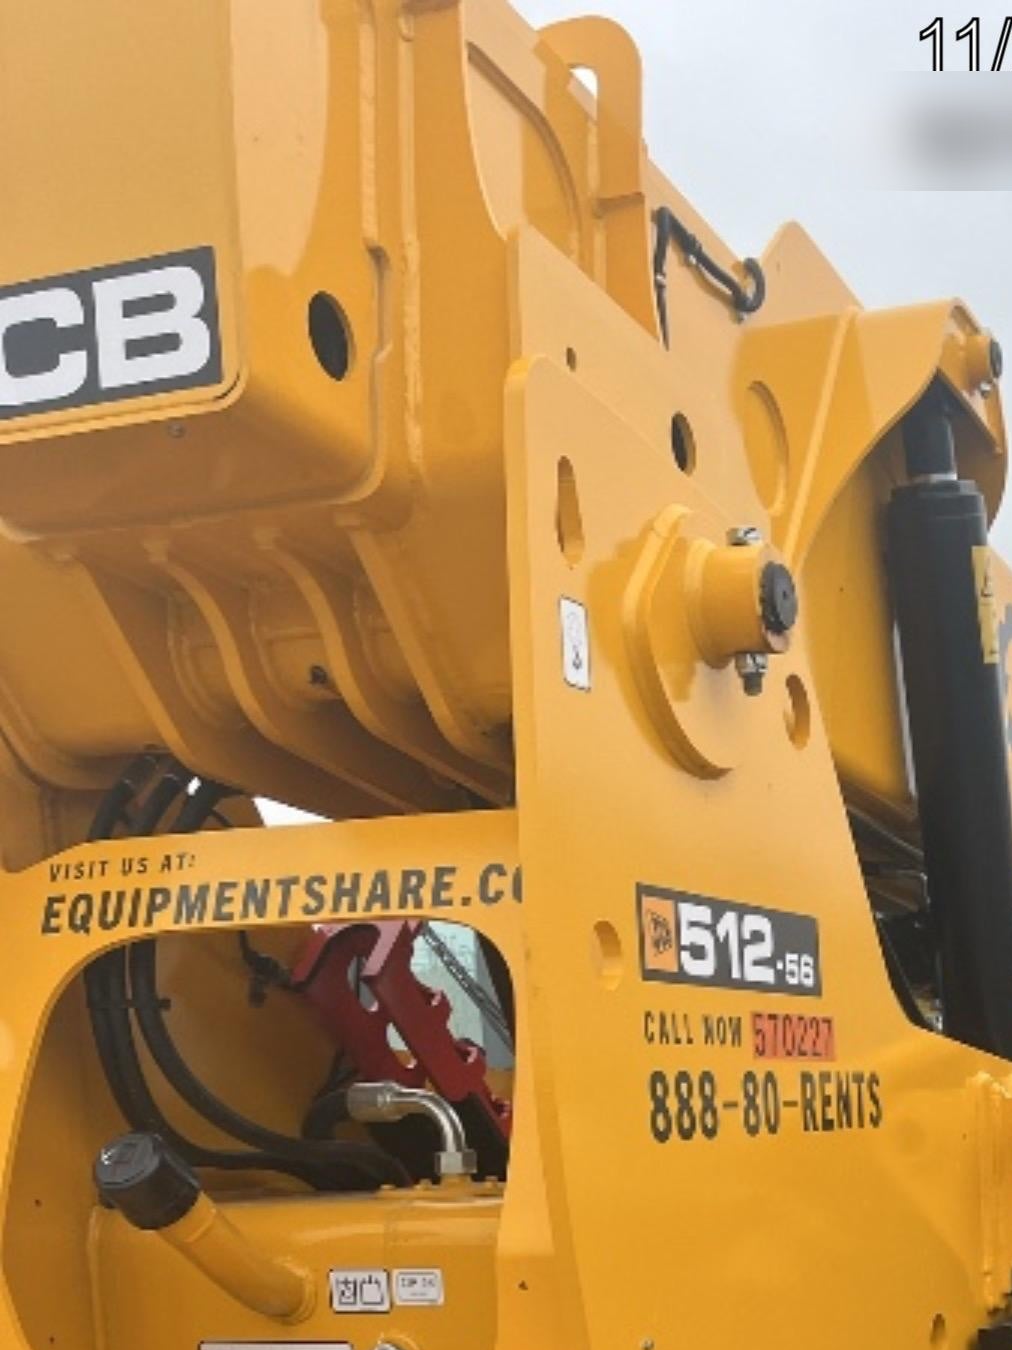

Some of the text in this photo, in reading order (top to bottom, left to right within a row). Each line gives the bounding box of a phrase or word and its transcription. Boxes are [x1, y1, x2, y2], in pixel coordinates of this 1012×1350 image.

[50, 853, 196, 882] VISIT US AT:
[644, 1010, 742, 1047] CALL NOW
[753, 1013, 833, 1057] 570227
[650, 1070, 882, 1143] 888-80-RENTS
